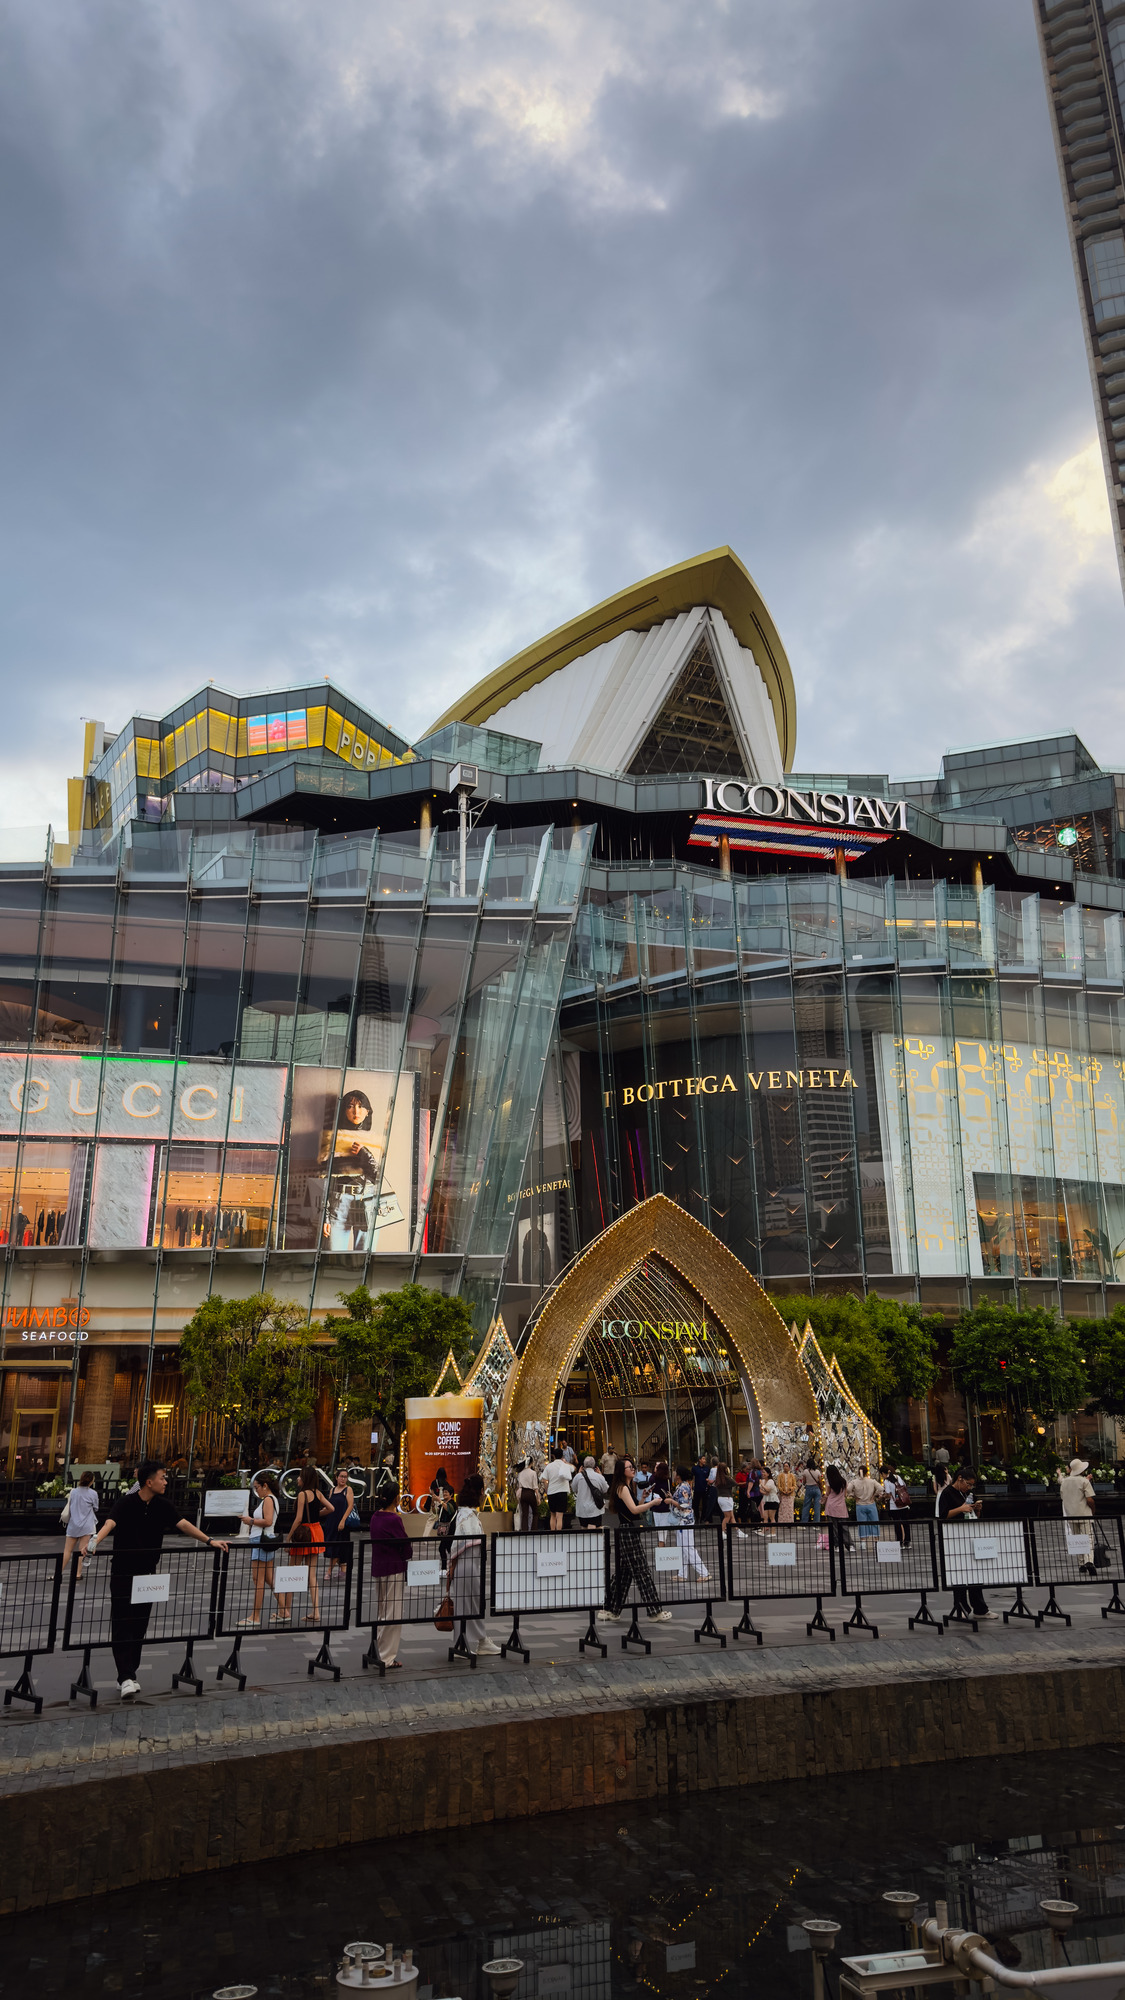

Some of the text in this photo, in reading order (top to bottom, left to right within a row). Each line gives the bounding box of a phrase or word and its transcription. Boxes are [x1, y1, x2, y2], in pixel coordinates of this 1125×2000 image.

[340, 732, 376, 766] POP
[702, 778, 910, 832] ICONSIAM
[9, 1076, 245, 1123] GUCCI
[622, 1073, 739, 1106] BOTTEGA
[747, 1069, 859, 1090] VENETA
[601, 1319, 709, 1341] ICONSIAM
[437, 1421, 461, 1431] ICONIC
[437, 1436, 460, 1445] COFFEE
